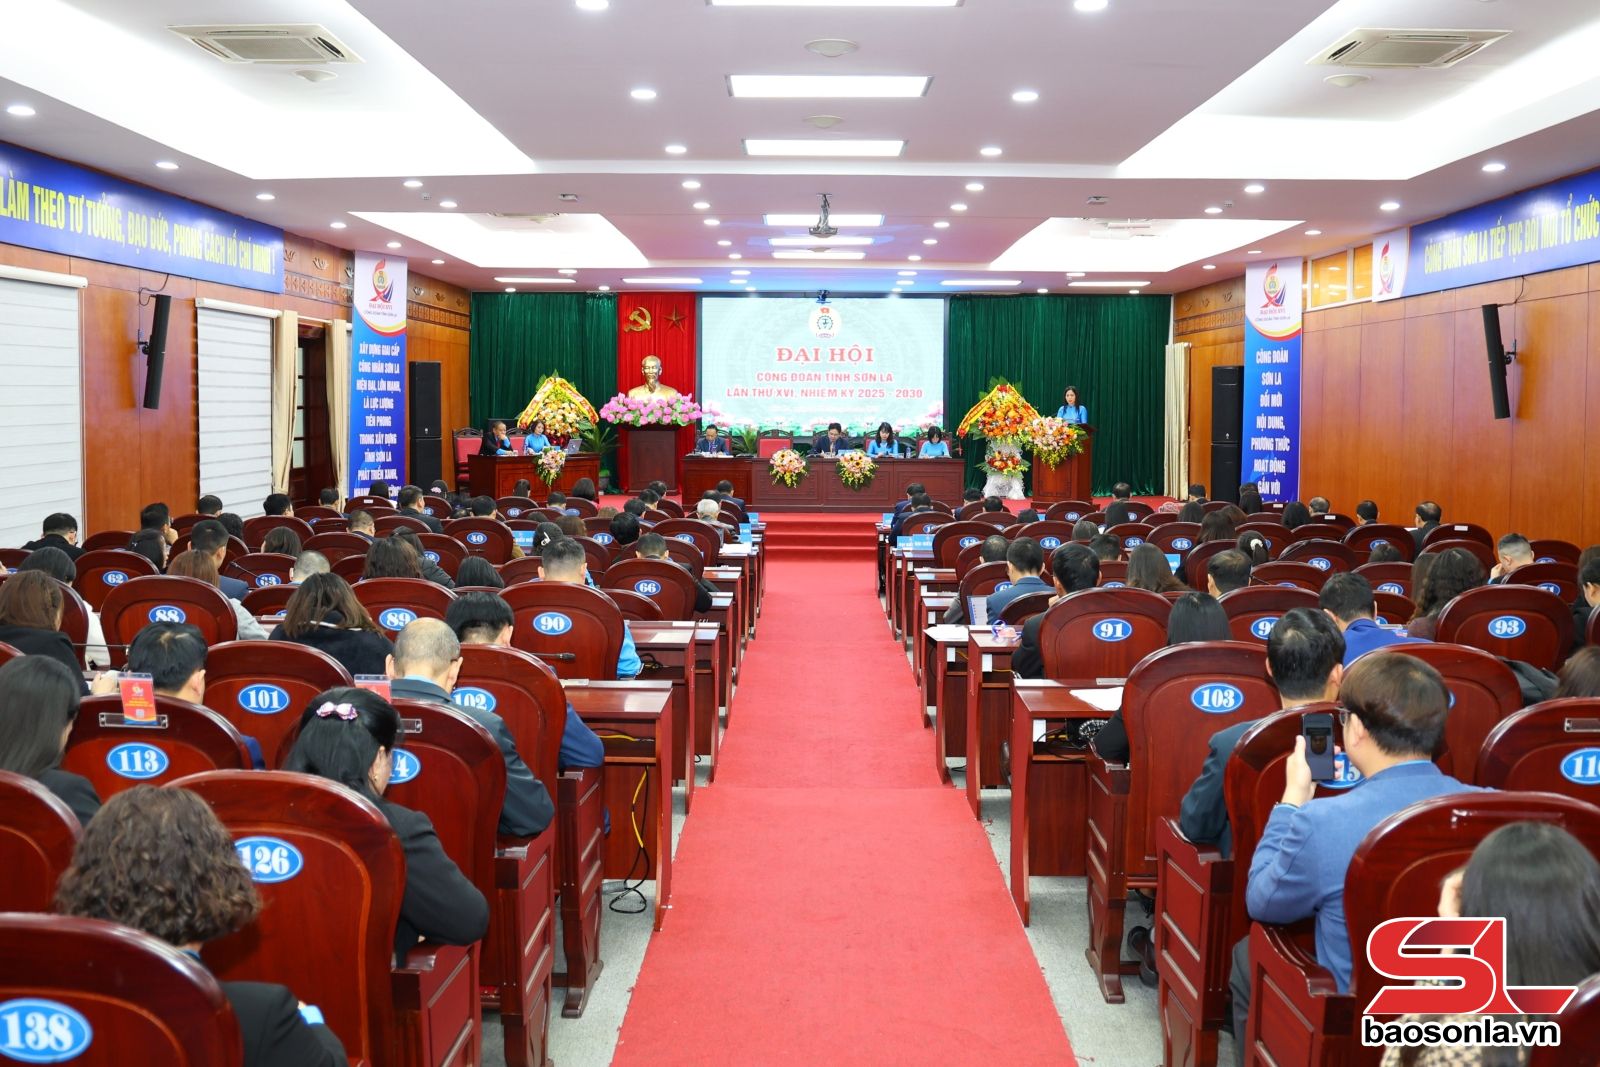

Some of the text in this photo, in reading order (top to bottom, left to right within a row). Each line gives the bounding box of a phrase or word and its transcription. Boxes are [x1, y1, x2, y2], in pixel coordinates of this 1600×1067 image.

[33, 186, 65, 230] THEO
[68, 195, 84, 234] TƯ
[128, 211, 148, 254] ĐẠO
[174, 224, 202, 260] PHONG
[1479, 230, 1488, 263] LA
[1574, 194, 1600, 242] CHỨC
[776, 344, 874, 366] ĐẠI HỘI
[880, 373, 893, 382] LA
[1275, 372, 1282, 385] LA
[858, 388, 885, 398] 2025
[896, 388, 923, 398] 2030
[108, 573, 124, 583] 62
[640, 582, 656, 592] 66
[156, 608, 180, 622] 88
[386, 613, 410, 627] 89
[541, 617, 565, 631] 90
[1101, 623, 1123, 638] 91
[1258, 621, 1274, 636] 9
[1495, 620, 1519, 634] 93
[248, 690, 280, 709] 101
[1201, 689, 1235, 707] 103
[117, 750, 159, 772] 113
[1572, 755, 1600, 778] 11
[1334, 759, 1361, 781] 15
[240, 846, 290, 874] 126
[2, 1010, 74, 1051] 138
